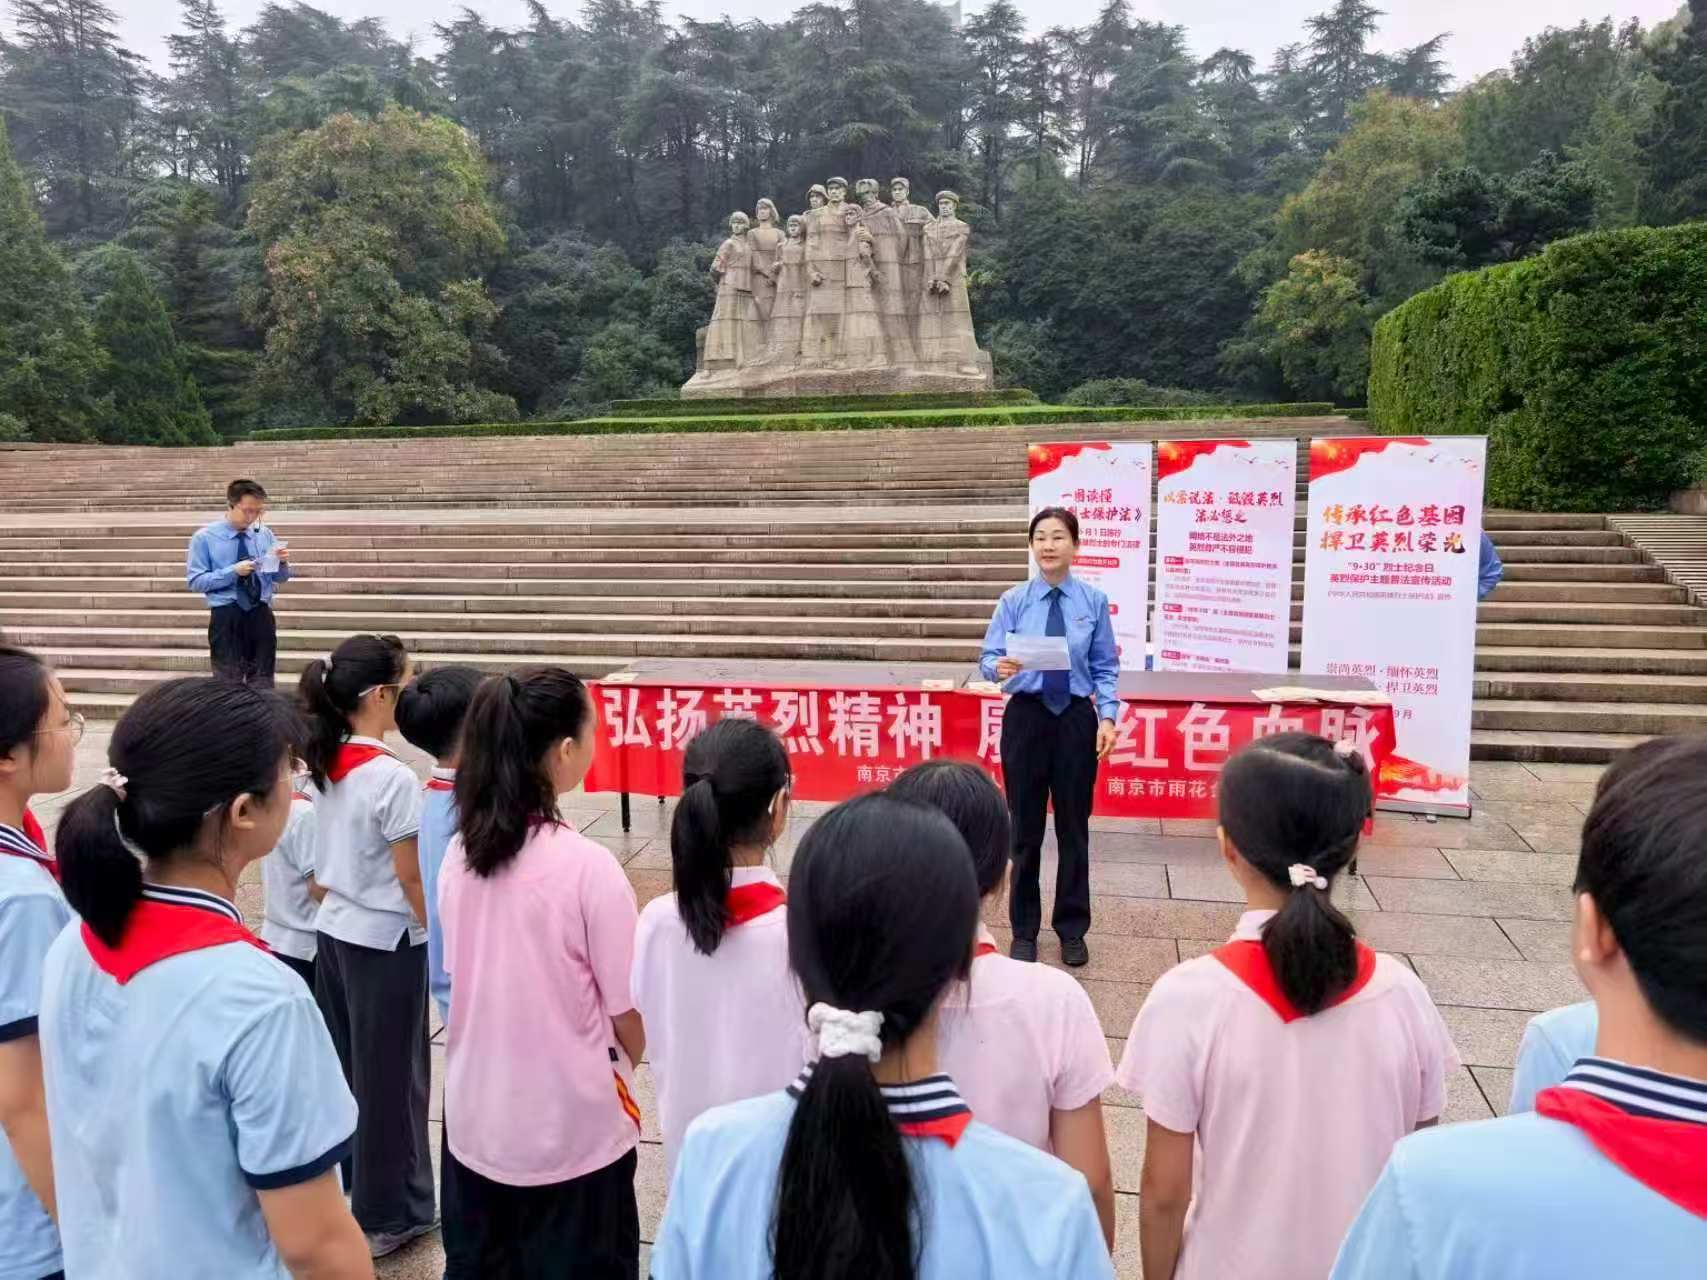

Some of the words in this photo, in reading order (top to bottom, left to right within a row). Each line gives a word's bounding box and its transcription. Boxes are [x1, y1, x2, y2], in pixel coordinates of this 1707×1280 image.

[1322, 503, 1466, 526] 传承红色基因
[1320, 531, 1466, 553] 捍卫英烈荣光
[1329, 573, 1452, 586] 英烈保护主题普法宣传活动
